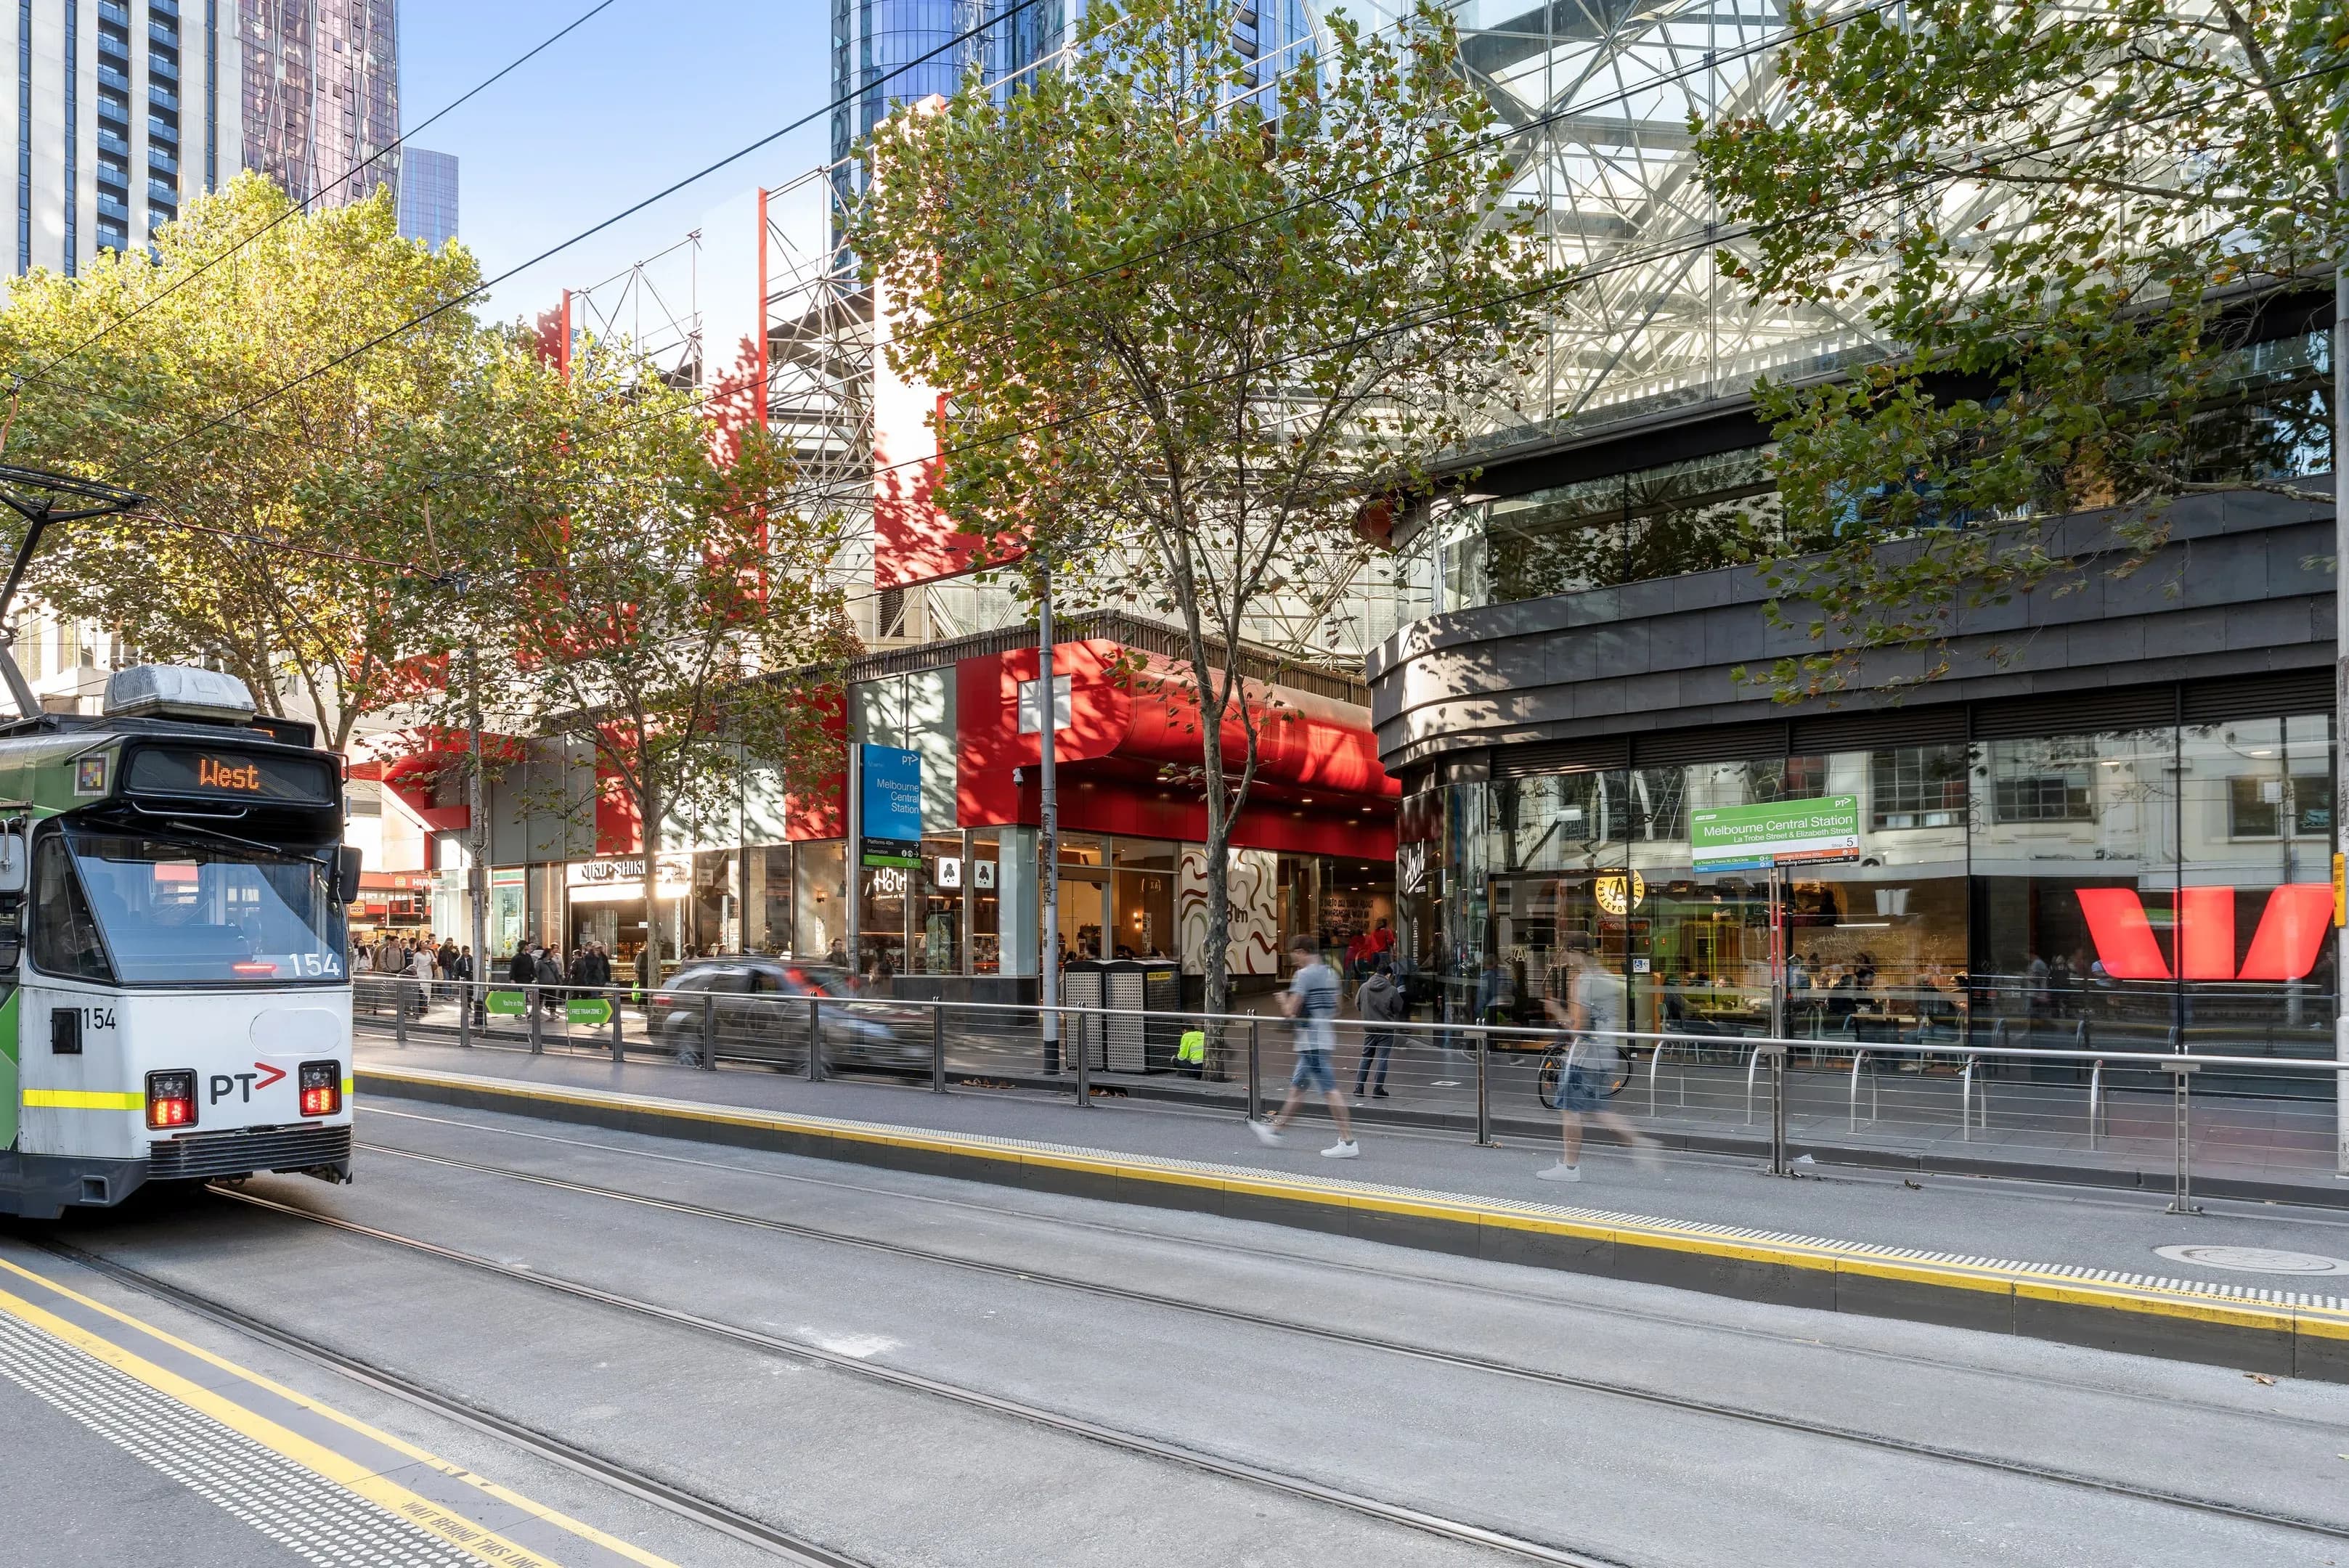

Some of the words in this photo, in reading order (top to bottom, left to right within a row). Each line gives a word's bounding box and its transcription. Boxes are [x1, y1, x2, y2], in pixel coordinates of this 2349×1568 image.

[200, 759, 259, 789] West
[876, 778, 919, 792] Melbourne
[890, 791, 919, 803] Central
[891, 802, 919, 814] Station
[1703, 824, 1763, 837] Melbourne
[1766, 818, 1808, 831] Central
[1811, 815, 1853, 828] Station
[1796, 829, 1829, 838] Elizabeth
[1847, 837, 1854, 847] 5
[289, 953, 341, 976] 154
[84, 1008, 116, 1029] 154
[401, 1501, 440, 1519] WAIT
[429, 1516, 481, 1542] BEHIND
[472, 1538, 512, 1557] THIS
